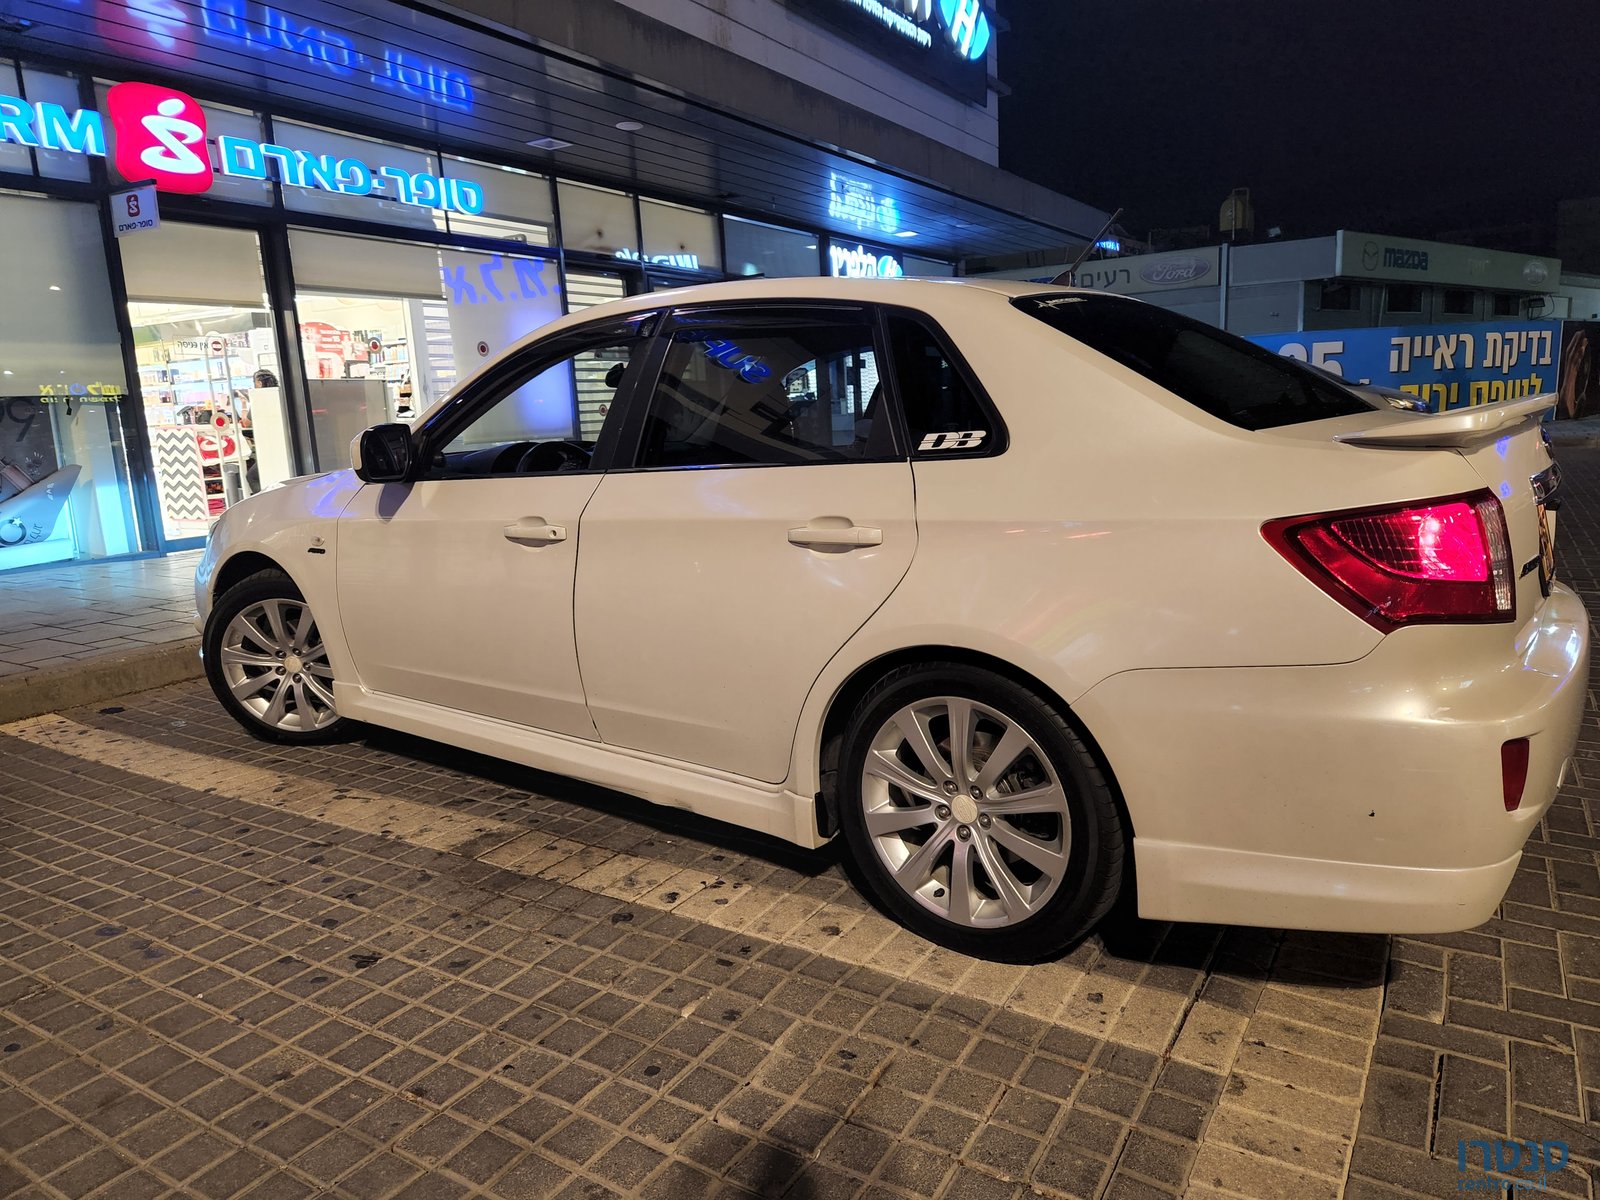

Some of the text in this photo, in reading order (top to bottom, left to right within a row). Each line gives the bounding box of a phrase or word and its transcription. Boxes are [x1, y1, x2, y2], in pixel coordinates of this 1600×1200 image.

[216, 135, 485, 215] סופר-פארם
[118, 219, 154, 232] סופר-פארם
[1080, 269, 1131, 288] רעים
[1152, 262, 1198, 281] Ford
[1389, 329, 1553, 375] בדיקת ראייה
